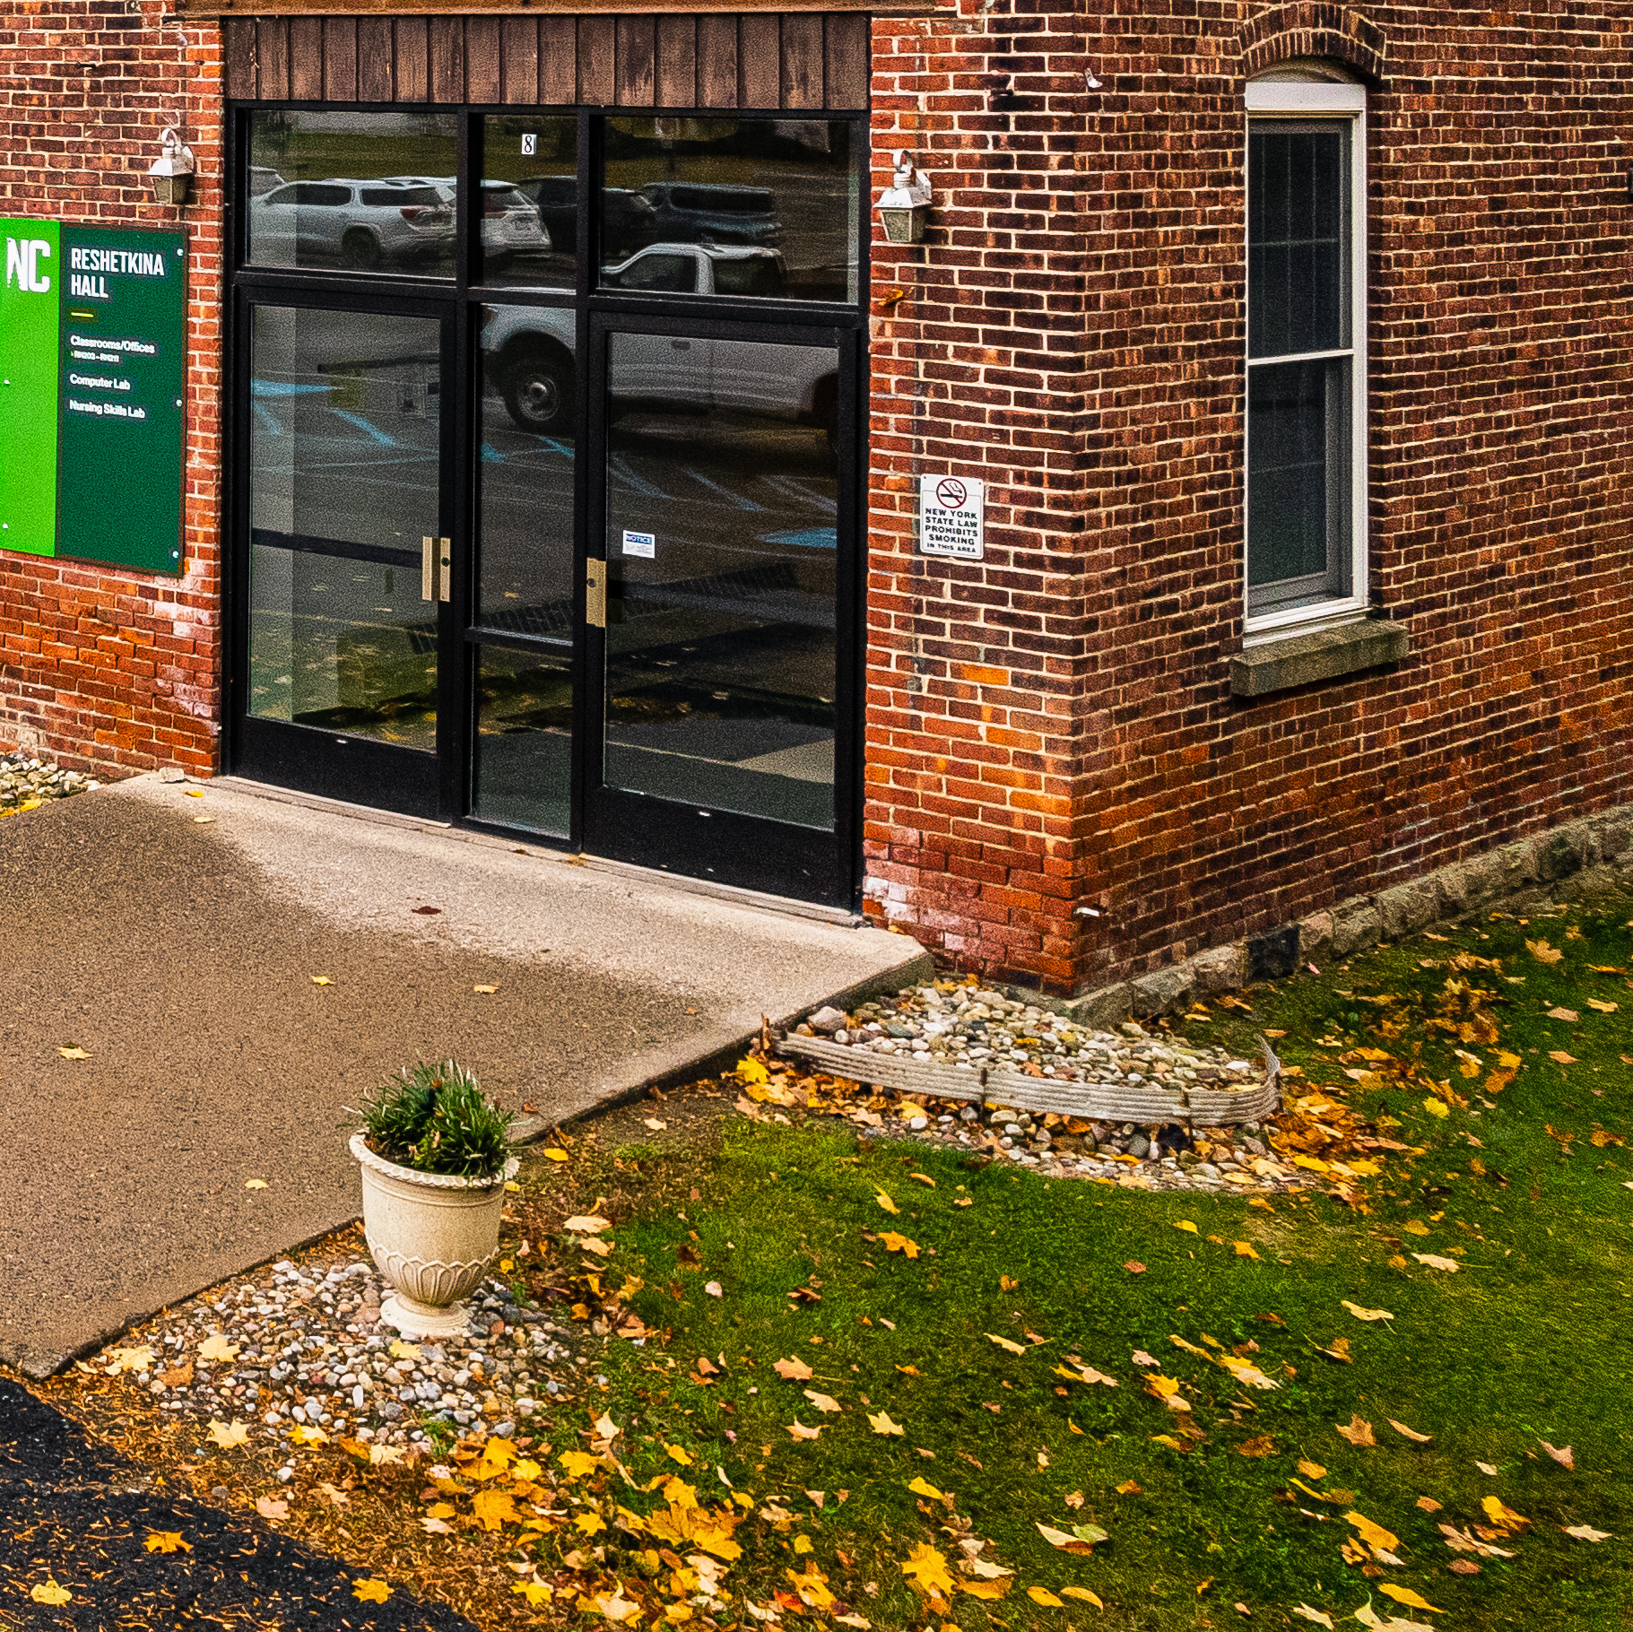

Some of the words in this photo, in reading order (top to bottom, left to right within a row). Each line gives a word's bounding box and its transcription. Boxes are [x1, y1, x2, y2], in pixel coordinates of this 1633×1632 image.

[524, 135, 532, 153] 8
[6, 237, 51, 293] NC
[70, 247, 165, 276] RESHETKINA
[70, 274, 109, 298] HALL
[70, 335, 155, 354] Classrooms/Offices
[69, 374, 113, 388] Computer
[113, 378, 131, 390] Lab
[69, 399, 103, 415] Nursing
[103, 403, 127, 416] Skills
[128, 406, 146, 419] Lab
[925, 508, 947, 516] NEW
[950, 510, 978, 519] YORK
[925, 516, 954, 525] STATE
[925, 525, 977, 536] PROHIBITS
[929, 534, 974, 545] SMOKING
